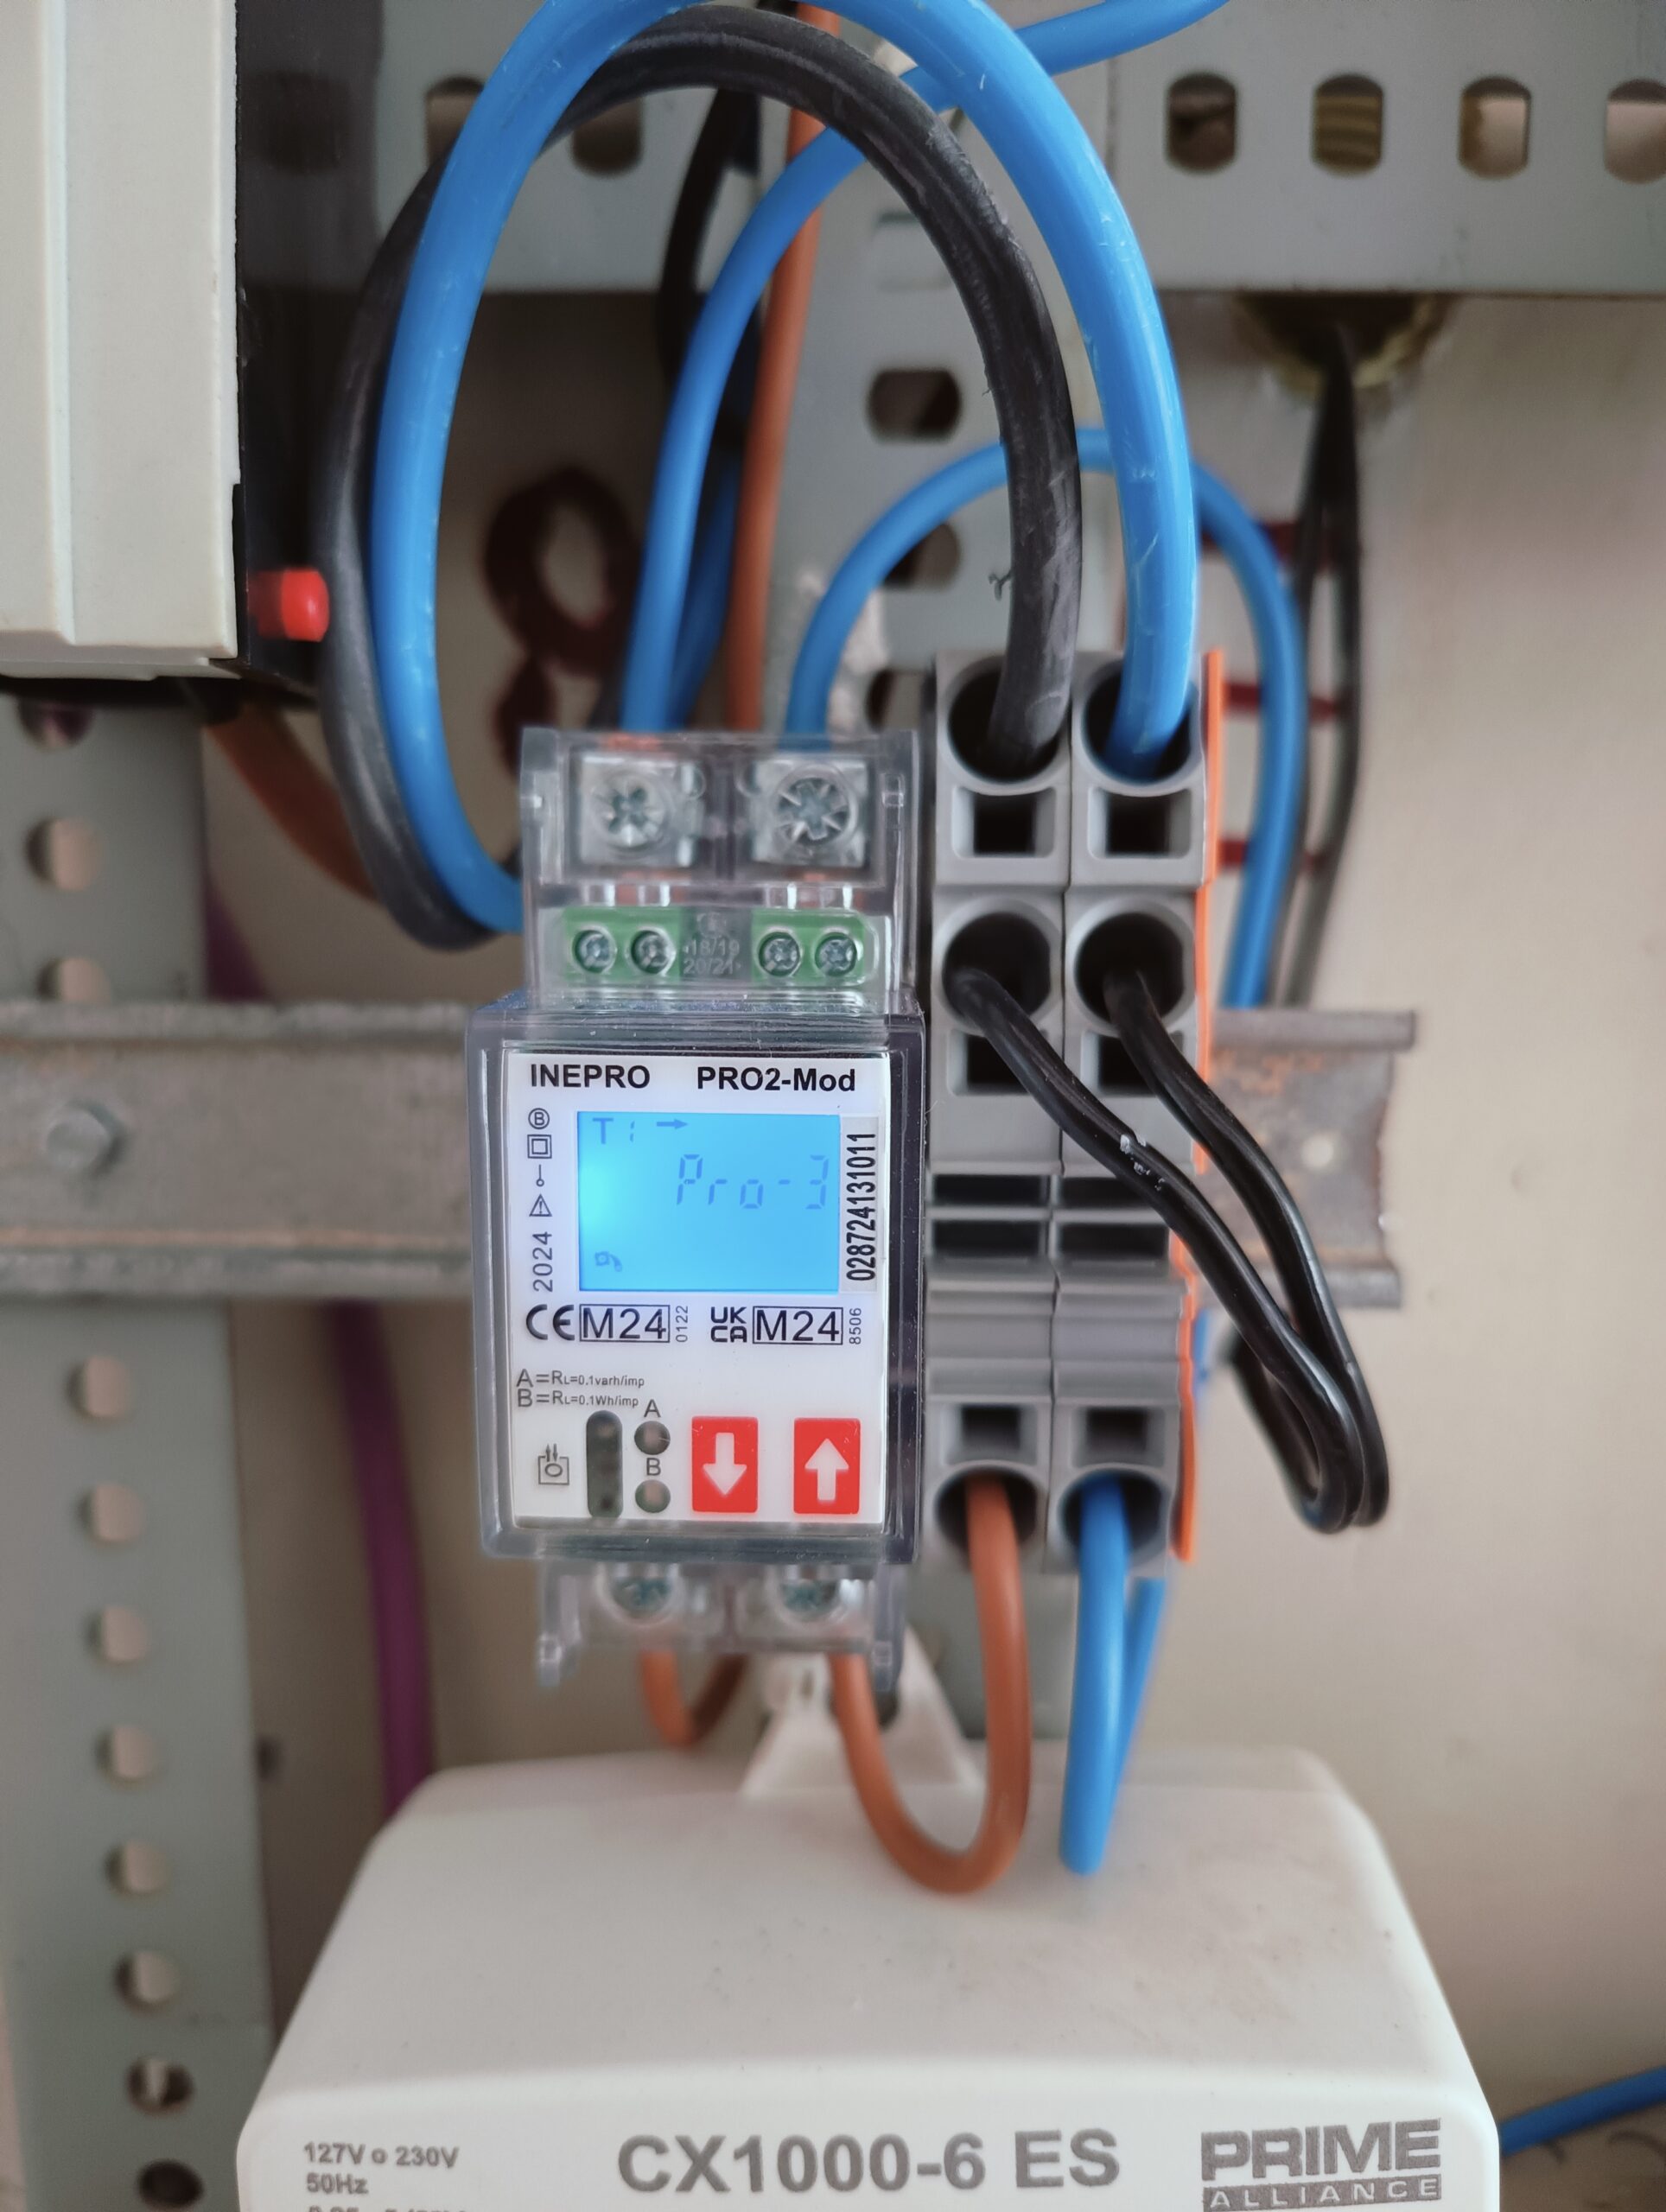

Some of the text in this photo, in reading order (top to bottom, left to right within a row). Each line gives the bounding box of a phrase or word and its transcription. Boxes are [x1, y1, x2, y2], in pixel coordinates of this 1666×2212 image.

[531, 1064, 856, 1091] INEPRO PRO2-Mod
[677, 1154, 830, 1210] Pro-3
[846, 1134, 876, 1281] 028724131011
[532, 1231, 553, 1293] 2024
[525, 1304, 667, 1341] CE M24
[676, 1306, 689, 1343] 0122
[710, 1306, 747, 1325] UK
[756, 1309, 840, 1342] M24
[849, 1307, 862, 1345] 8506
[643, 1399, 661, 1418] A
[645, 1458, 661, 1476] B
[304, 2141, 460, 2169] 127V o 230V
[617, 2127, 1121, 2193] CX1000-6 ES
[1201, 2118, 1441, 2181] PRIME
[306, 2172, 369, 2195] 50Hz
[1209, 2177, 1439, 2209] ALLIANCE
